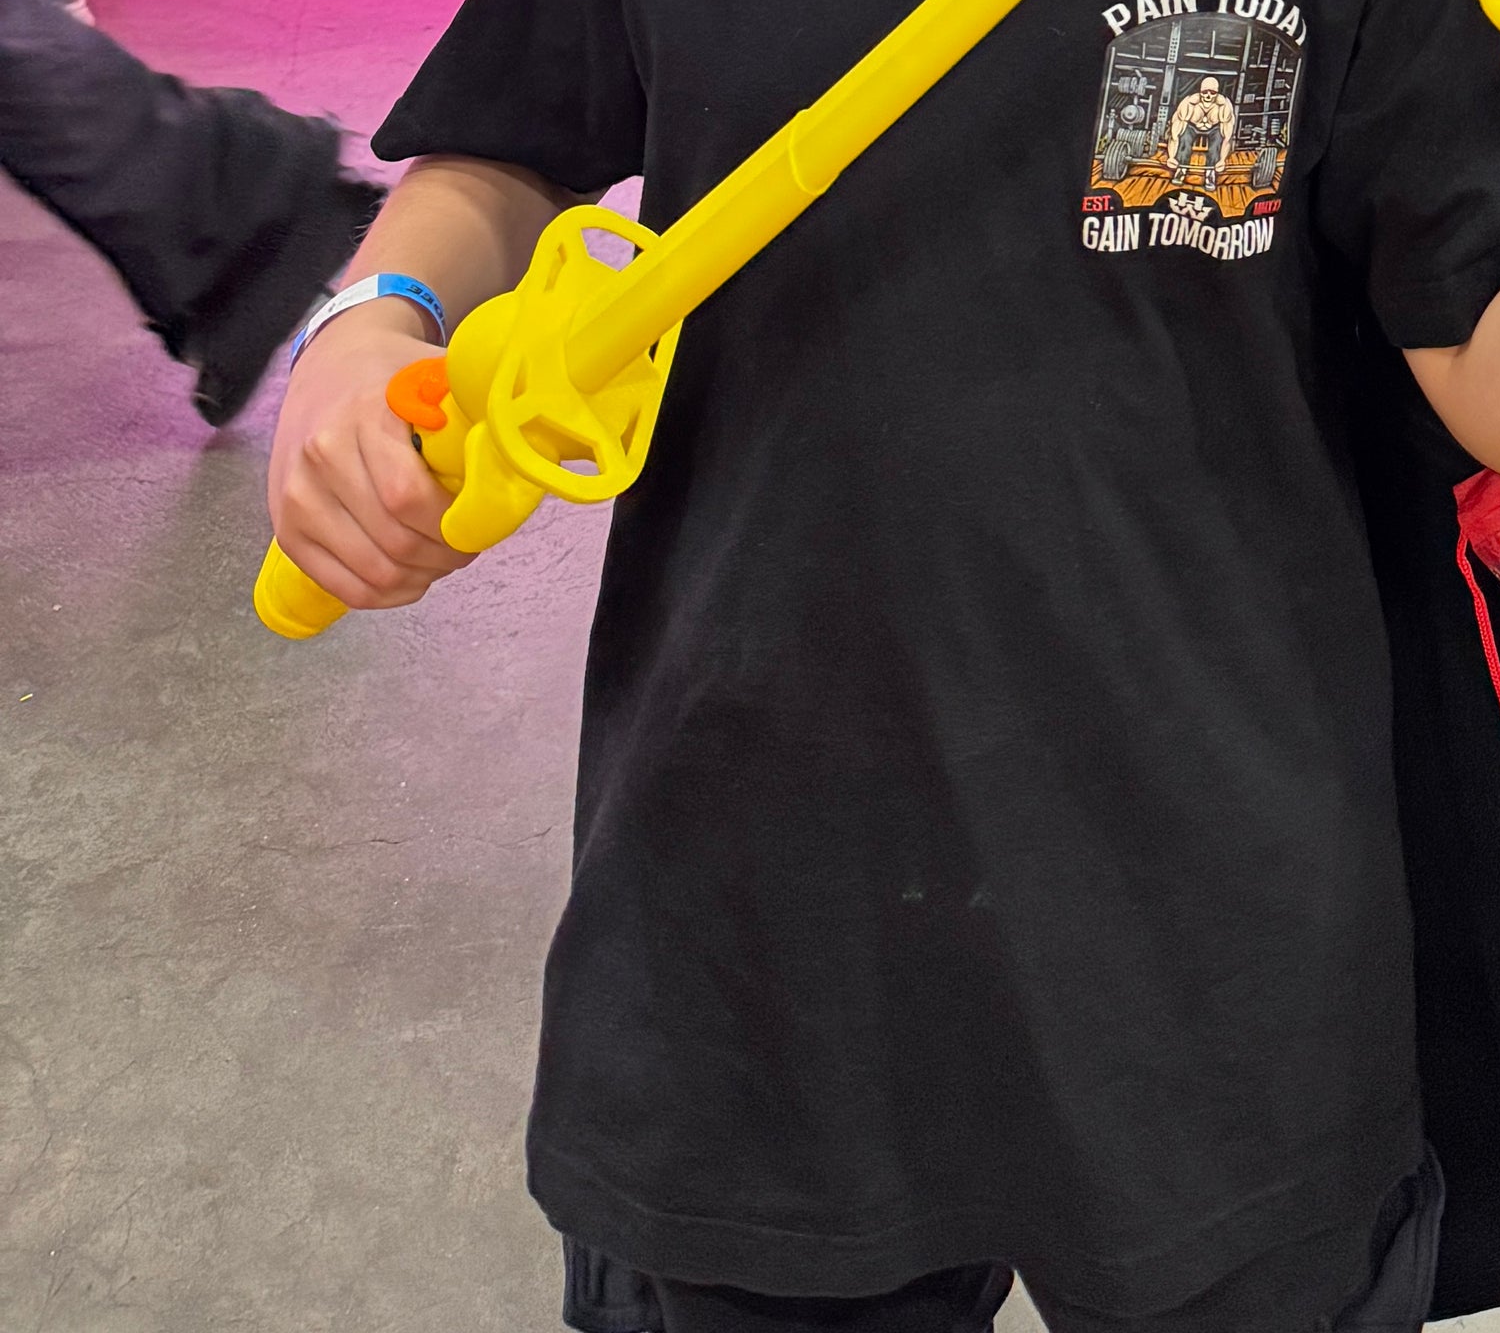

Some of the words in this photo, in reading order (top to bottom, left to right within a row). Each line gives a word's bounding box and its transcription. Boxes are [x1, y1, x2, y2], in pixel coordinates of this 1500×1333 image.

[1081, 194, 1114, 213] EST.
[1082, 212, 1141, 253] GAIN
[1147, 212, 1275, 261] TOMORROW
